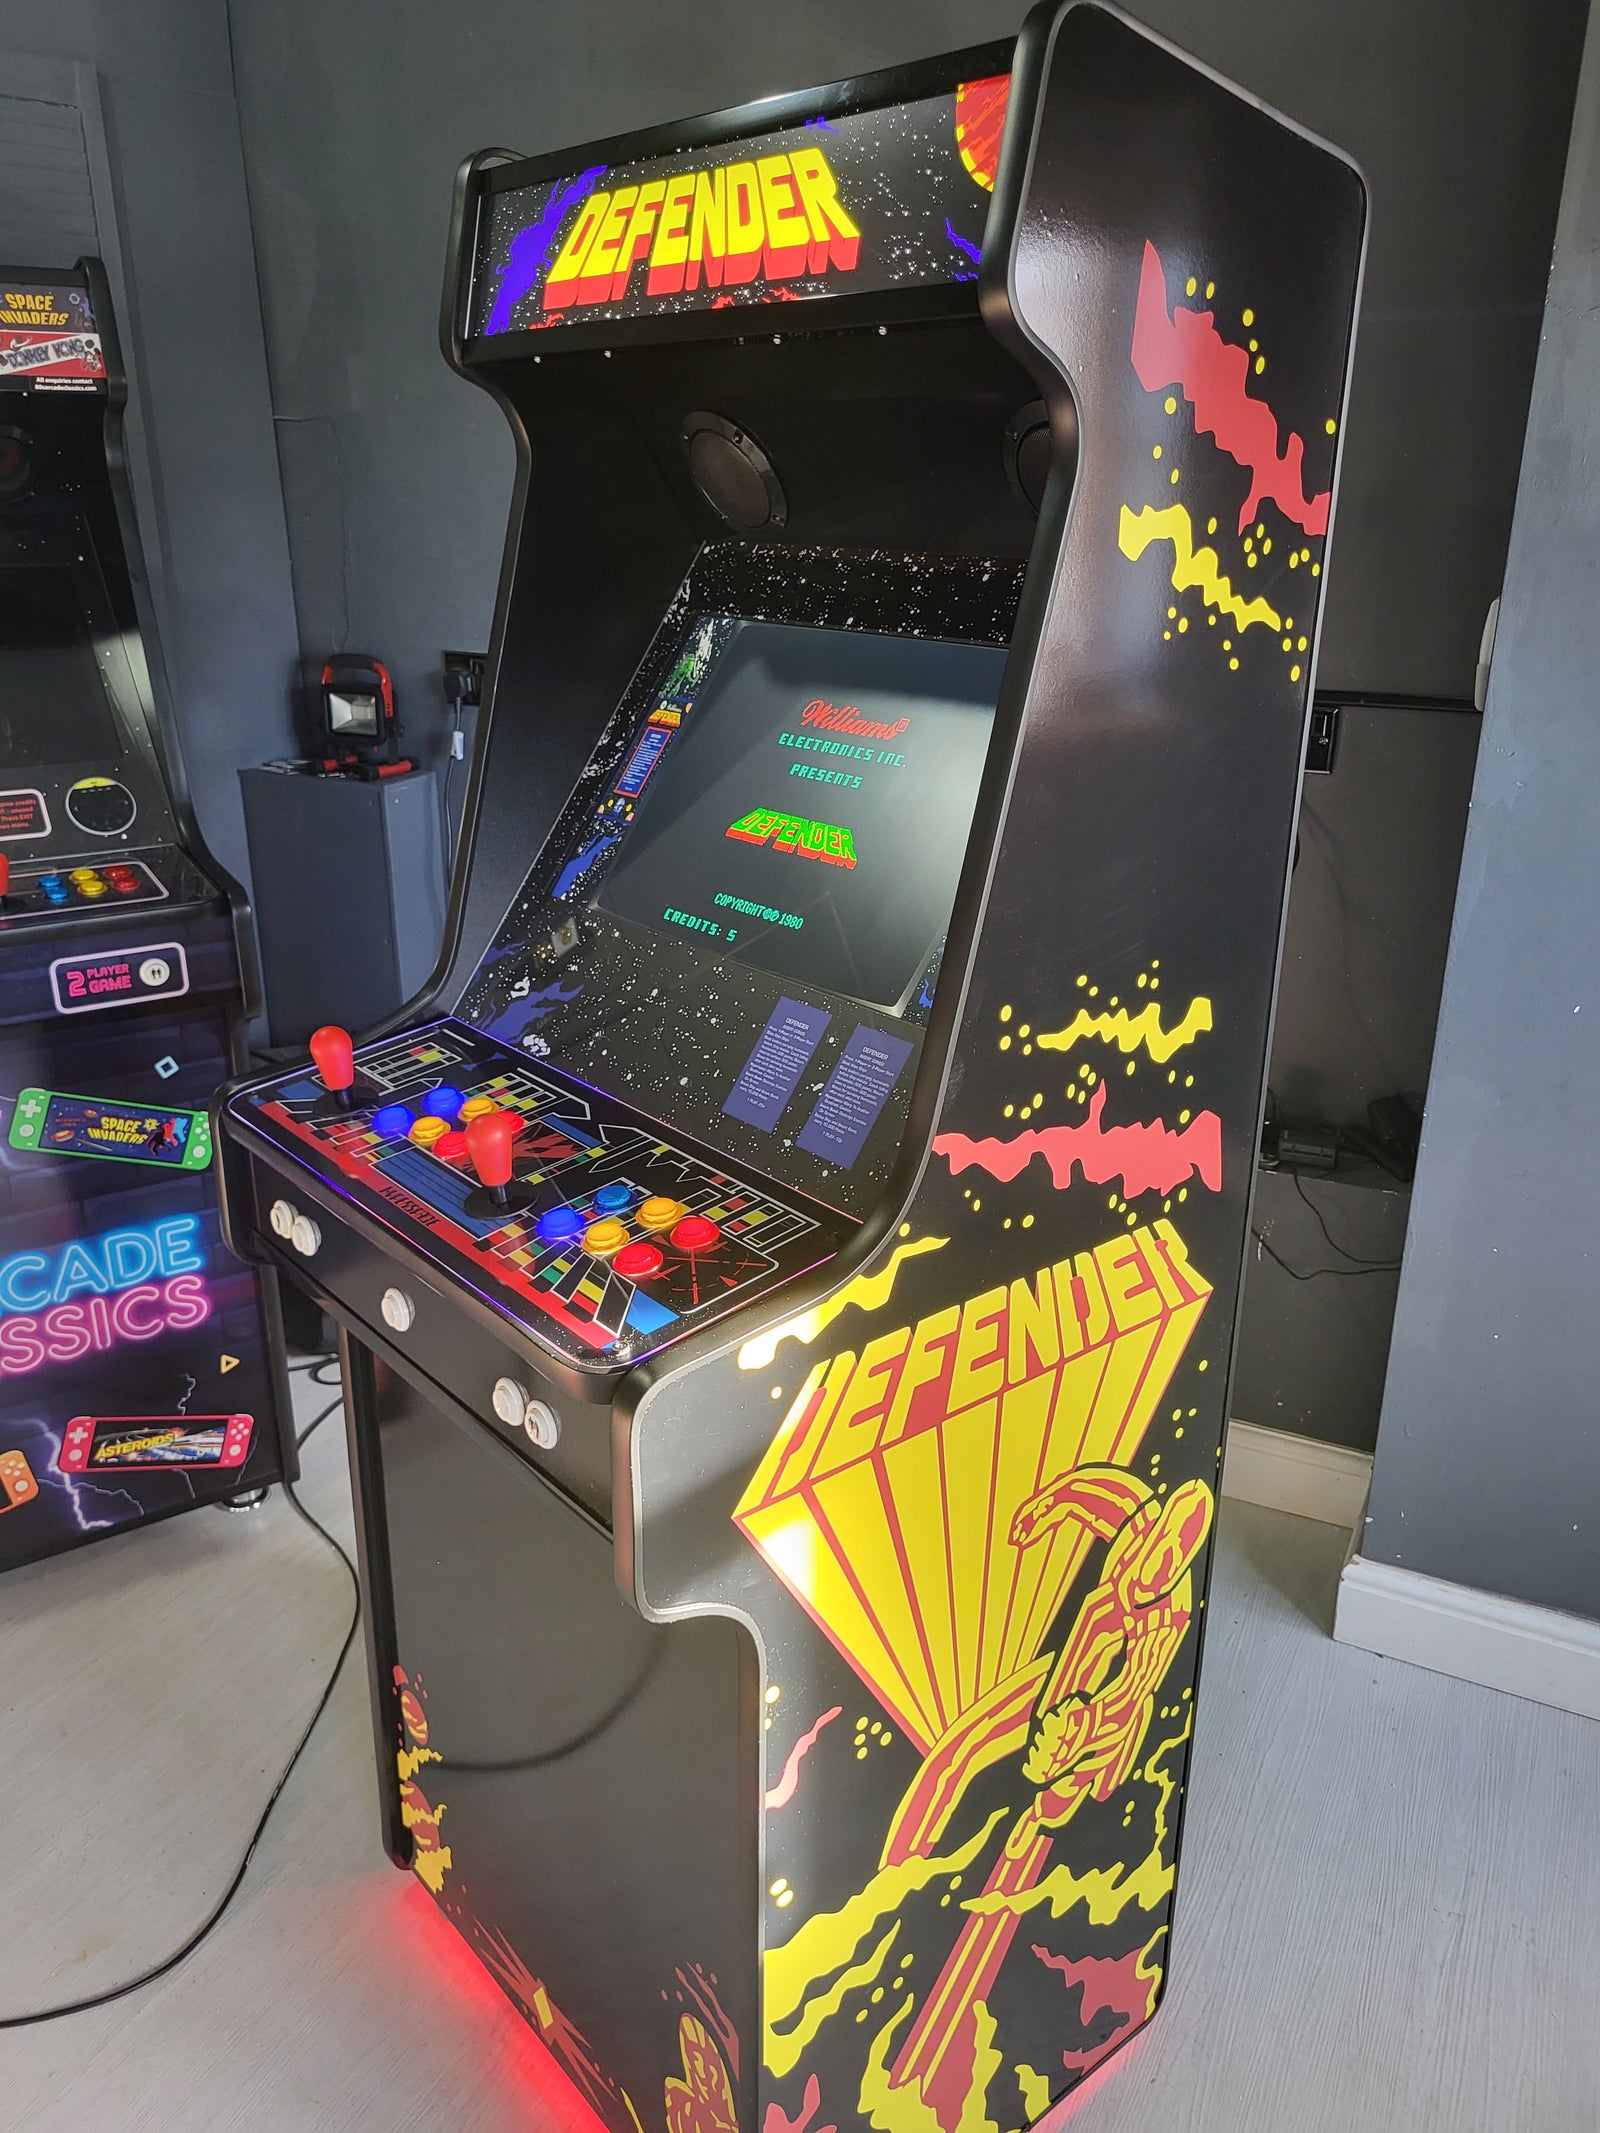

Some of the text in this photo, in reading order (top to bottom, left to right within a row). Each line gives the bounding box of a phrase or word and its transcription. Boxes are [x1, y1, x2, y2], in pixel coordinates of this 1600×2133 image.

[544, 147, 861, 310] DEFENDER
[5, 293, 54, 311] SPACE
[0, 310, 69, 325] INVADERS
[6, 338, 84, 369] DONKEY KONG
[779, 732, 906, 768] ELECTRONICS INC.
[789, 763, 863, 789] PRESENTS
[725, 807, 858, 870] DEFENDER
[663, 907, 738, 942] CREDITS: 5
[778, 912, 804, 930] 1980
[66, 963, 130, 997] 2 PLAYER
[88, 975, 133, 994] GAME
[862, 1046, 889, 1060] DEFENDER
[87, 1127, 148, 1145] INVADERS
[101, 1116, 142, 1132] SPACE
[732, 1218, 1214, 1520] DEFENDER
[94, 1433, 174, 1460] ASTEROIDS
